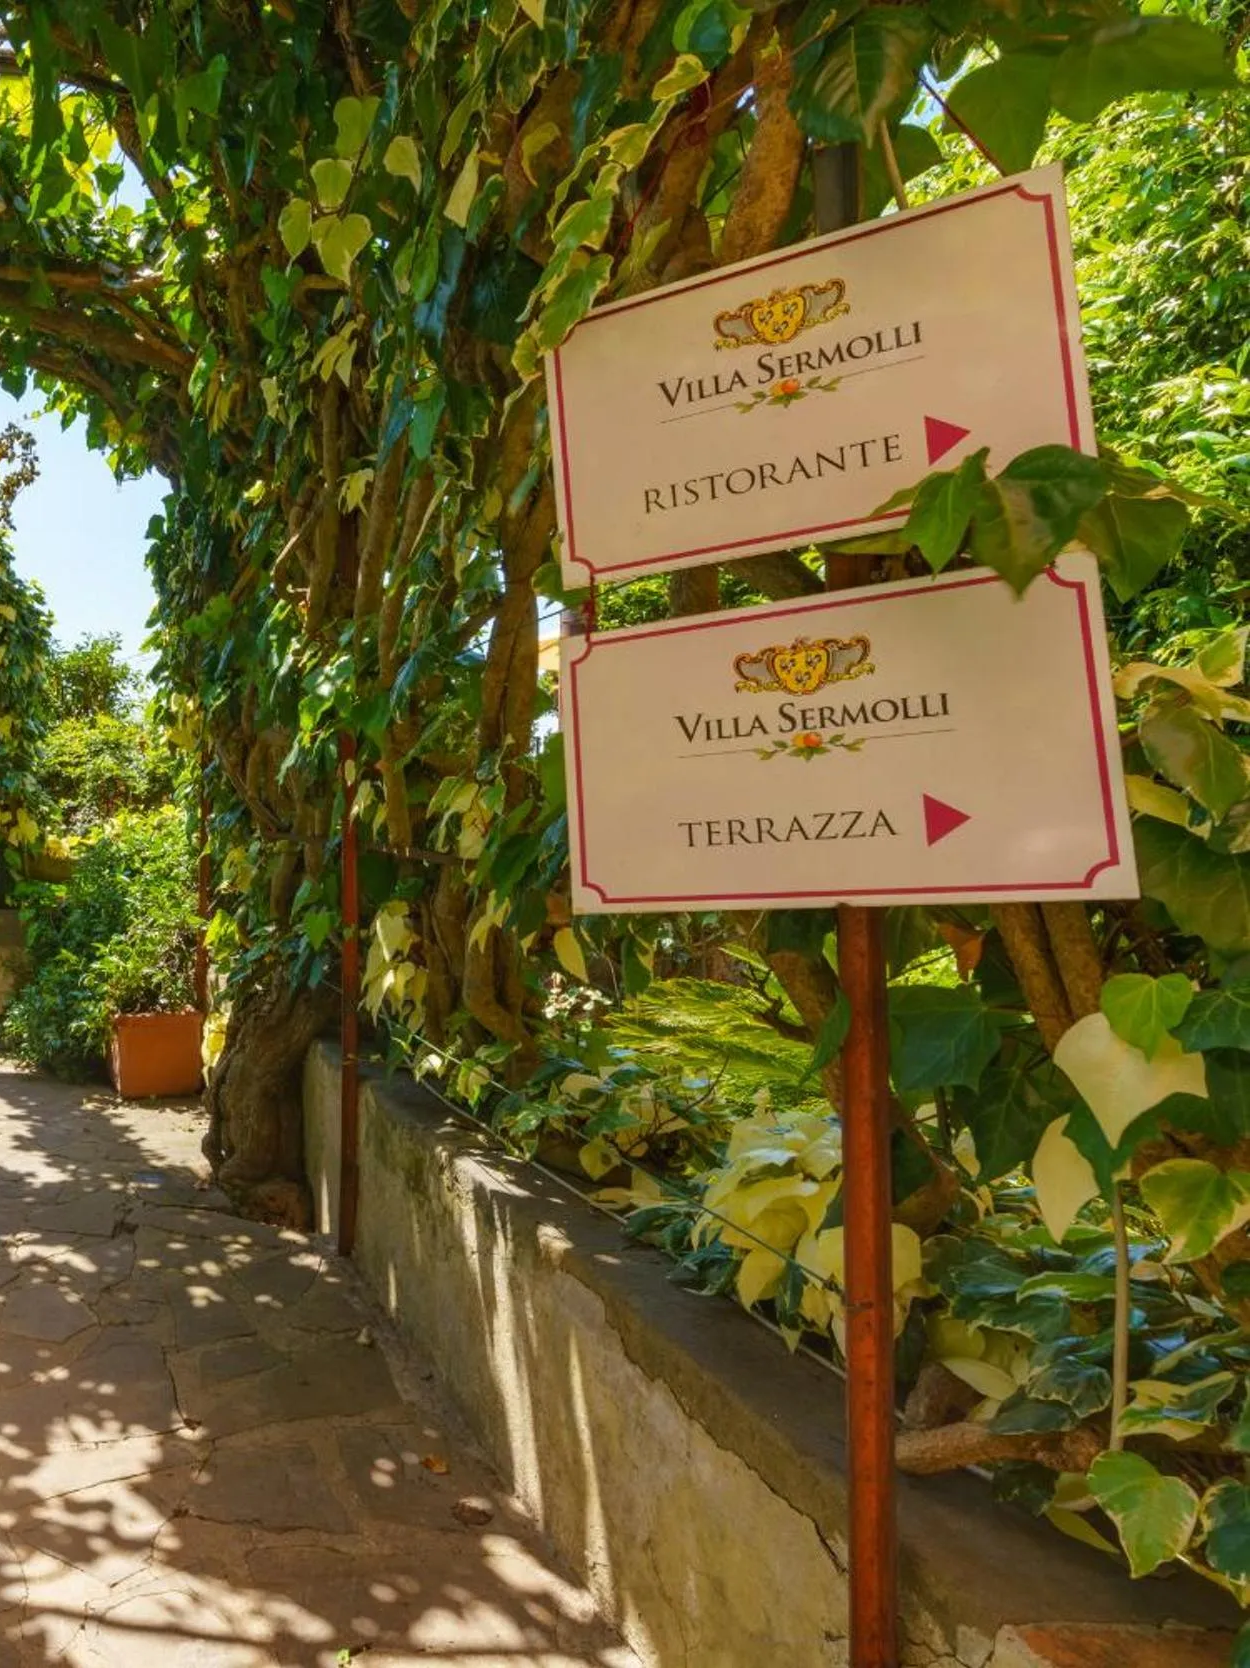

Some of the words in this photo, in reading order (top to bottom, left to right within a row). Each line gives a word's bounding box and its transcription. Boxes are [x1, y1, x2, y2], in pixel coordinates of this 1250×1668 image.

[656, 369, 748, 409] VILLA
[756, 320, 923, 384] SERMOLLI
[643, 433, 904, 514] RISTORANTE
[675, 712, 768, 744] VILLA
[777, 692, 950, 733] SERMOLLI
[678, 809, 899, 848] TERRAZZA
